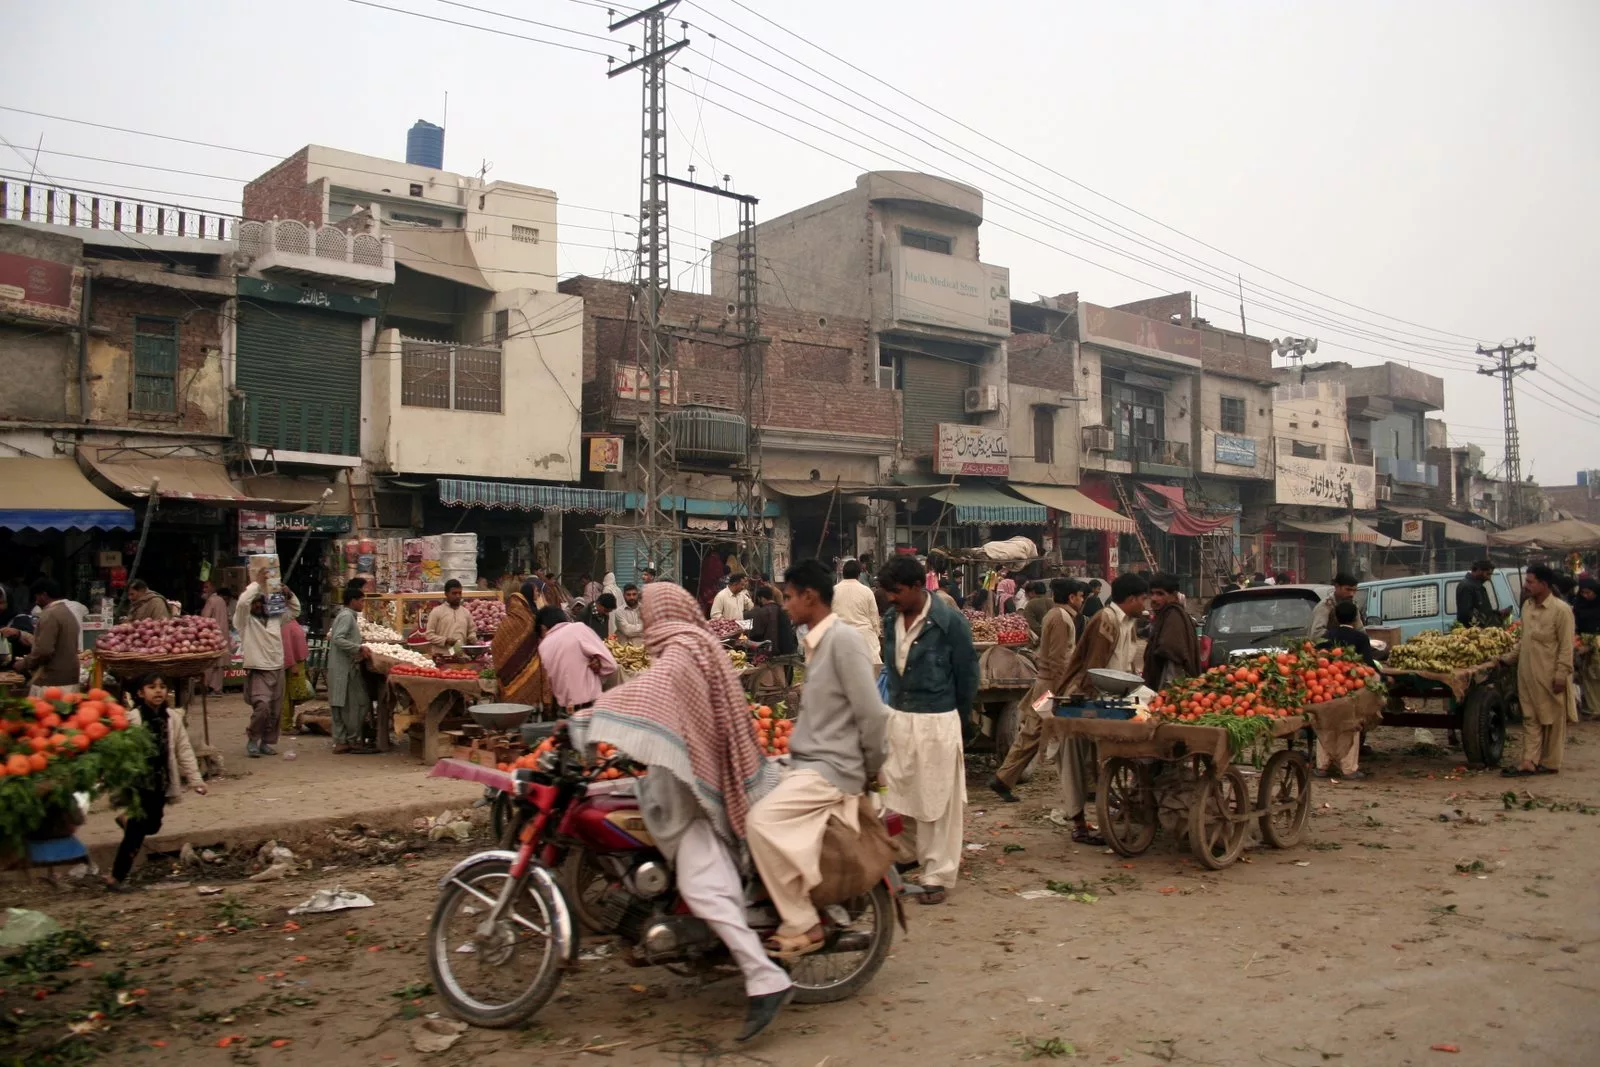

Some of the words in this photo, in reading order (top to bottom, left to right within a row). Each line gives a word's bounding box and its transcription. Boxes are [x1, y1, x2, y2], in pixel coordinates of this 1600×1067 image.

[906, 271, 928, 283] Malik
[930, 275, 958, 289] Medical
[960, 282, 978, 293] Store
[230, 669, 248, 677] JUIC
